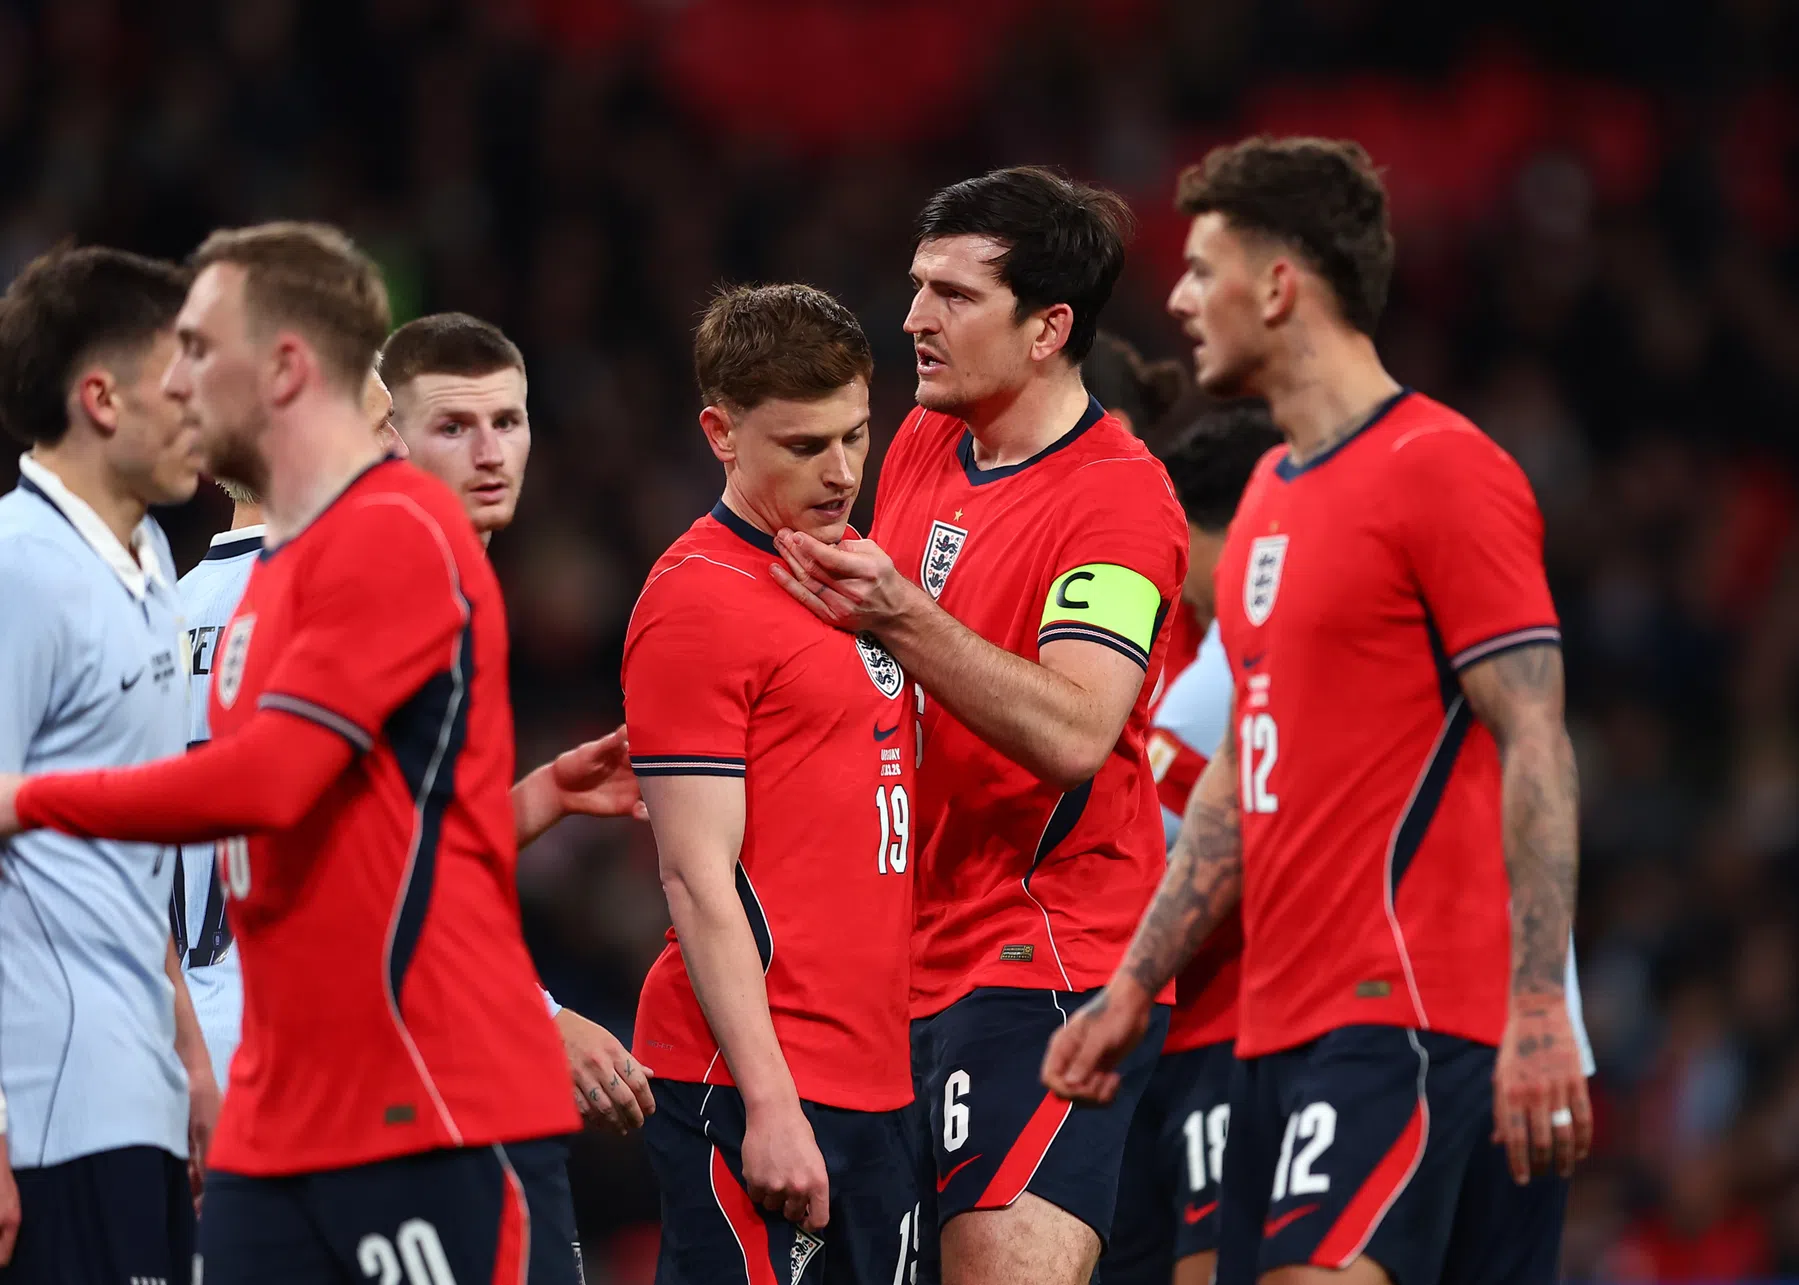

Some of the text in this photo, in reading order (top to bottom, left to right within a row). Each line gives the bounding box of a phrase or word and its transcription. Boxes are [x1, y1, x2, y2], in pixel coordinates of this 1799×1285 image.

[1056, 571, 1095, 609] C
[1240, 713, 1278, 813] 12
[875, 784, 910, 874] 19
[943, 1068, 970, 1153] 6
[1271, 1101, 1337, 1202] 12
[358, 1218, 457, 1285] 20
